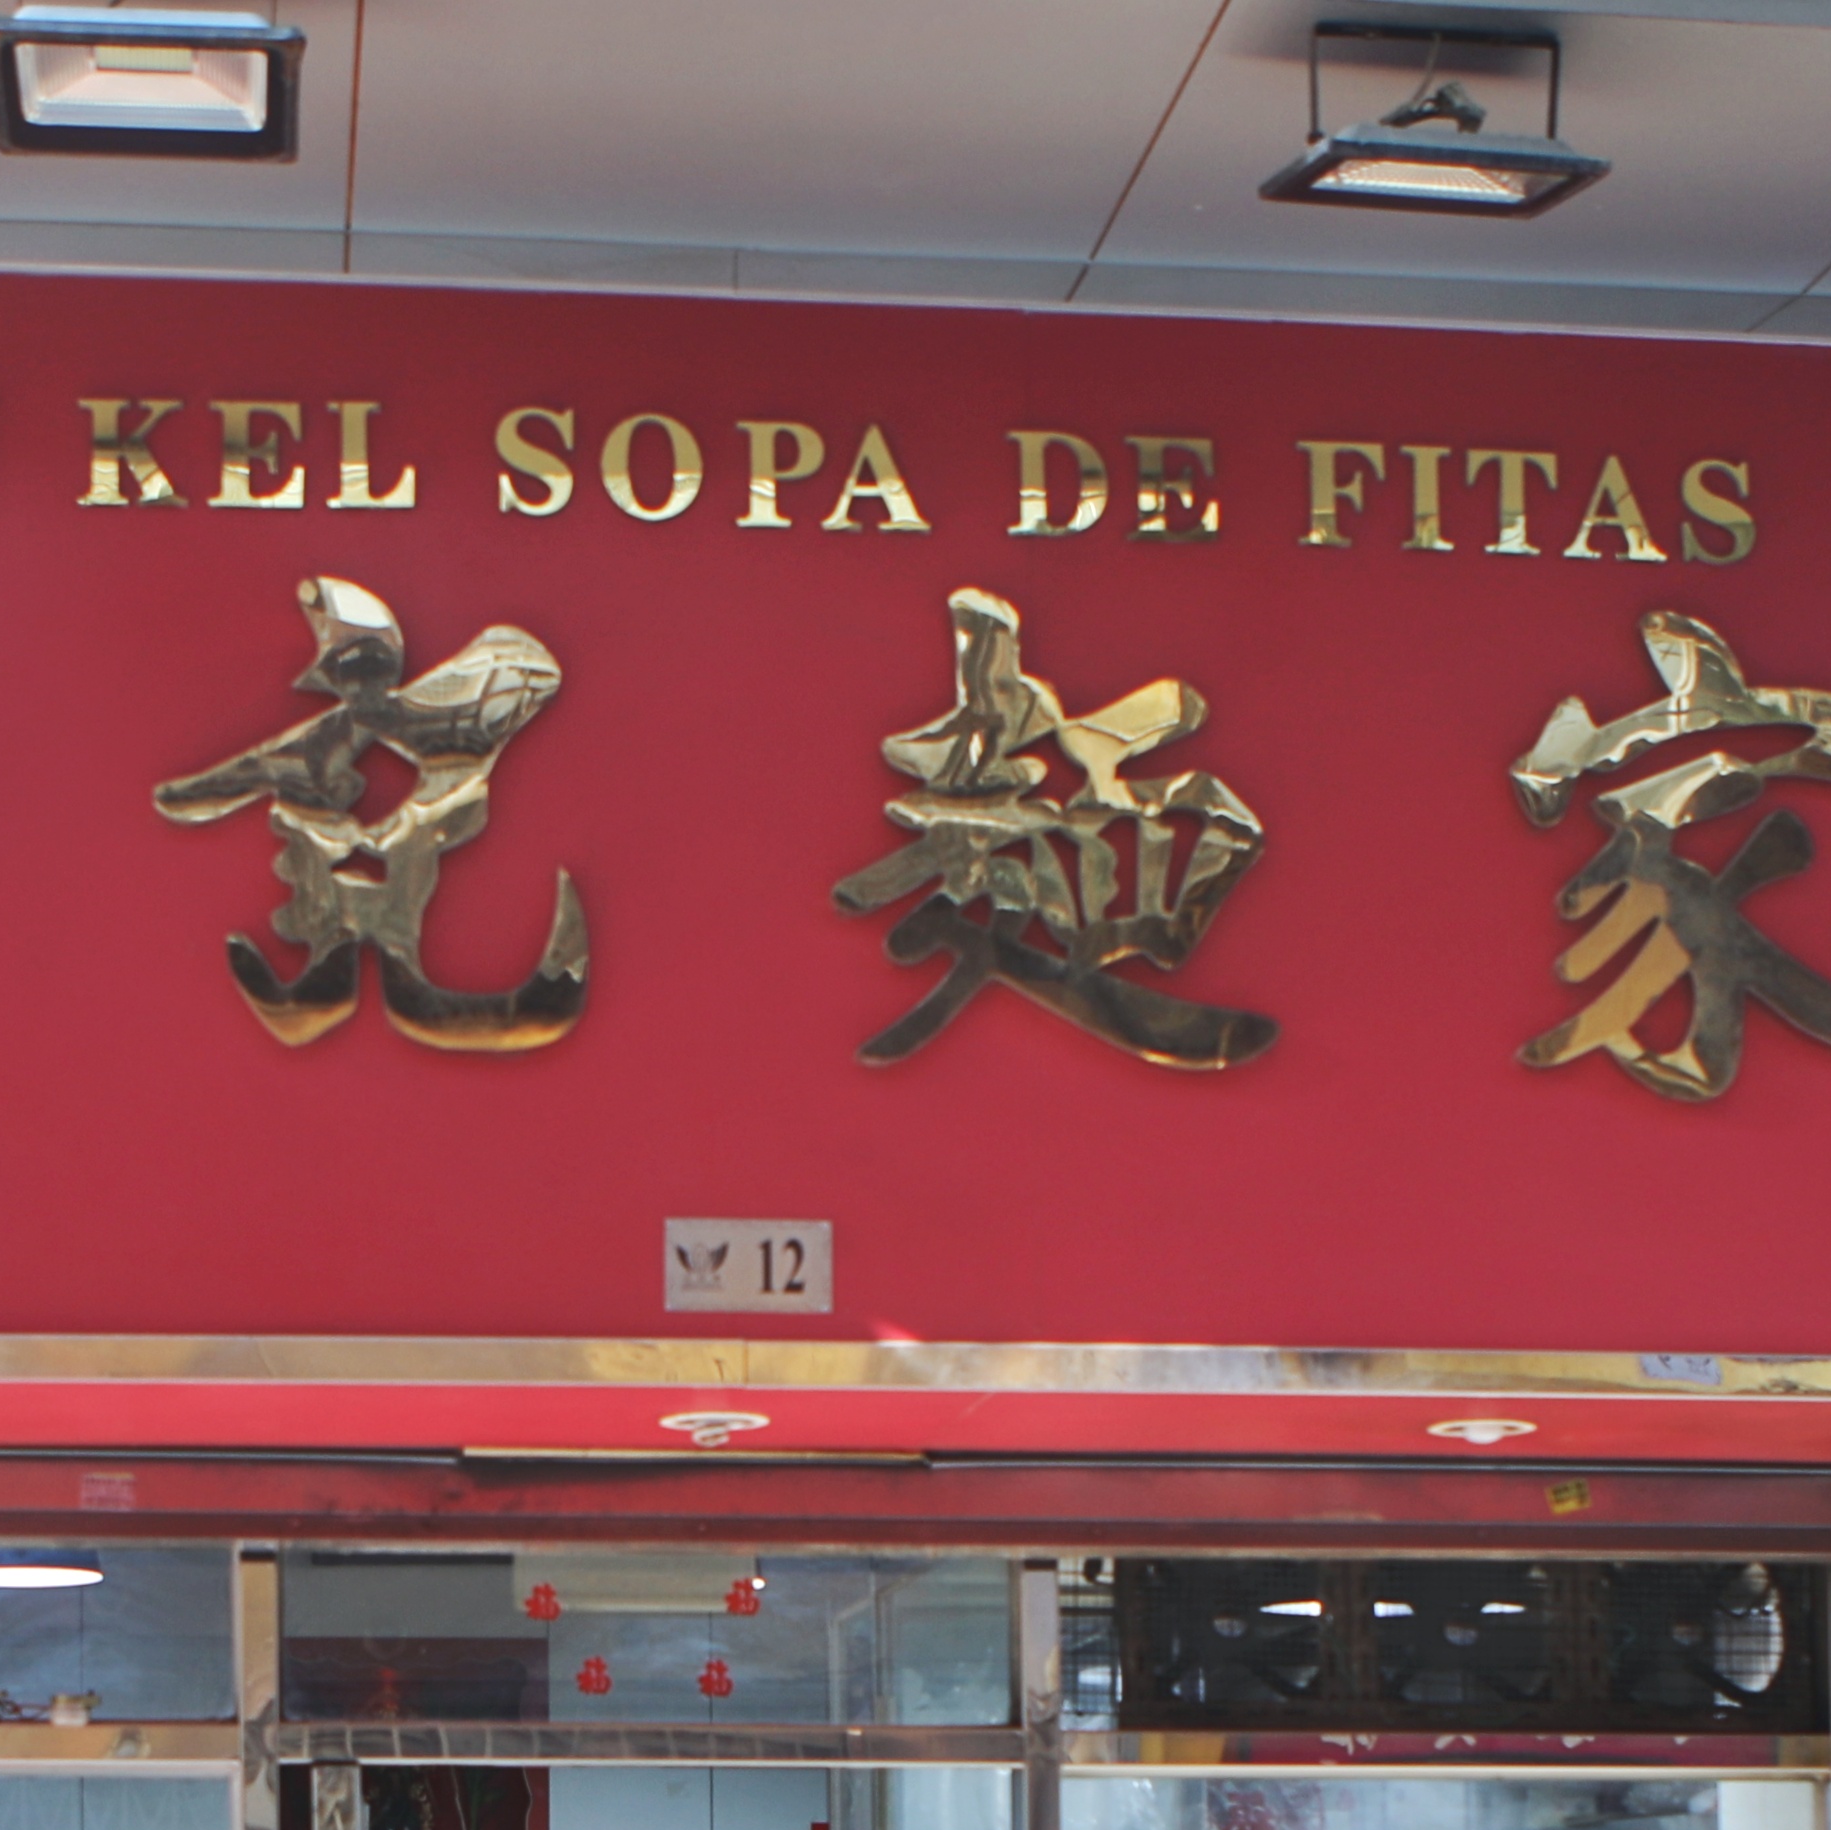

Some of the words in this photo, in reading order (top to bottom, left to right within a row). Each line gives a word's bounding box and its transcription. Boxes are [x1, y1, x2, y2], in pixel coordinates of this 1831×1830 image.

[76, 399, 417, 511] KEL
[495, 408, 932, 534] SOPA
[1006, 431, 1221, 542] DE
[1296, 440, 1758, 565] FITAS
[758, 1237, 807, 1295] 12
